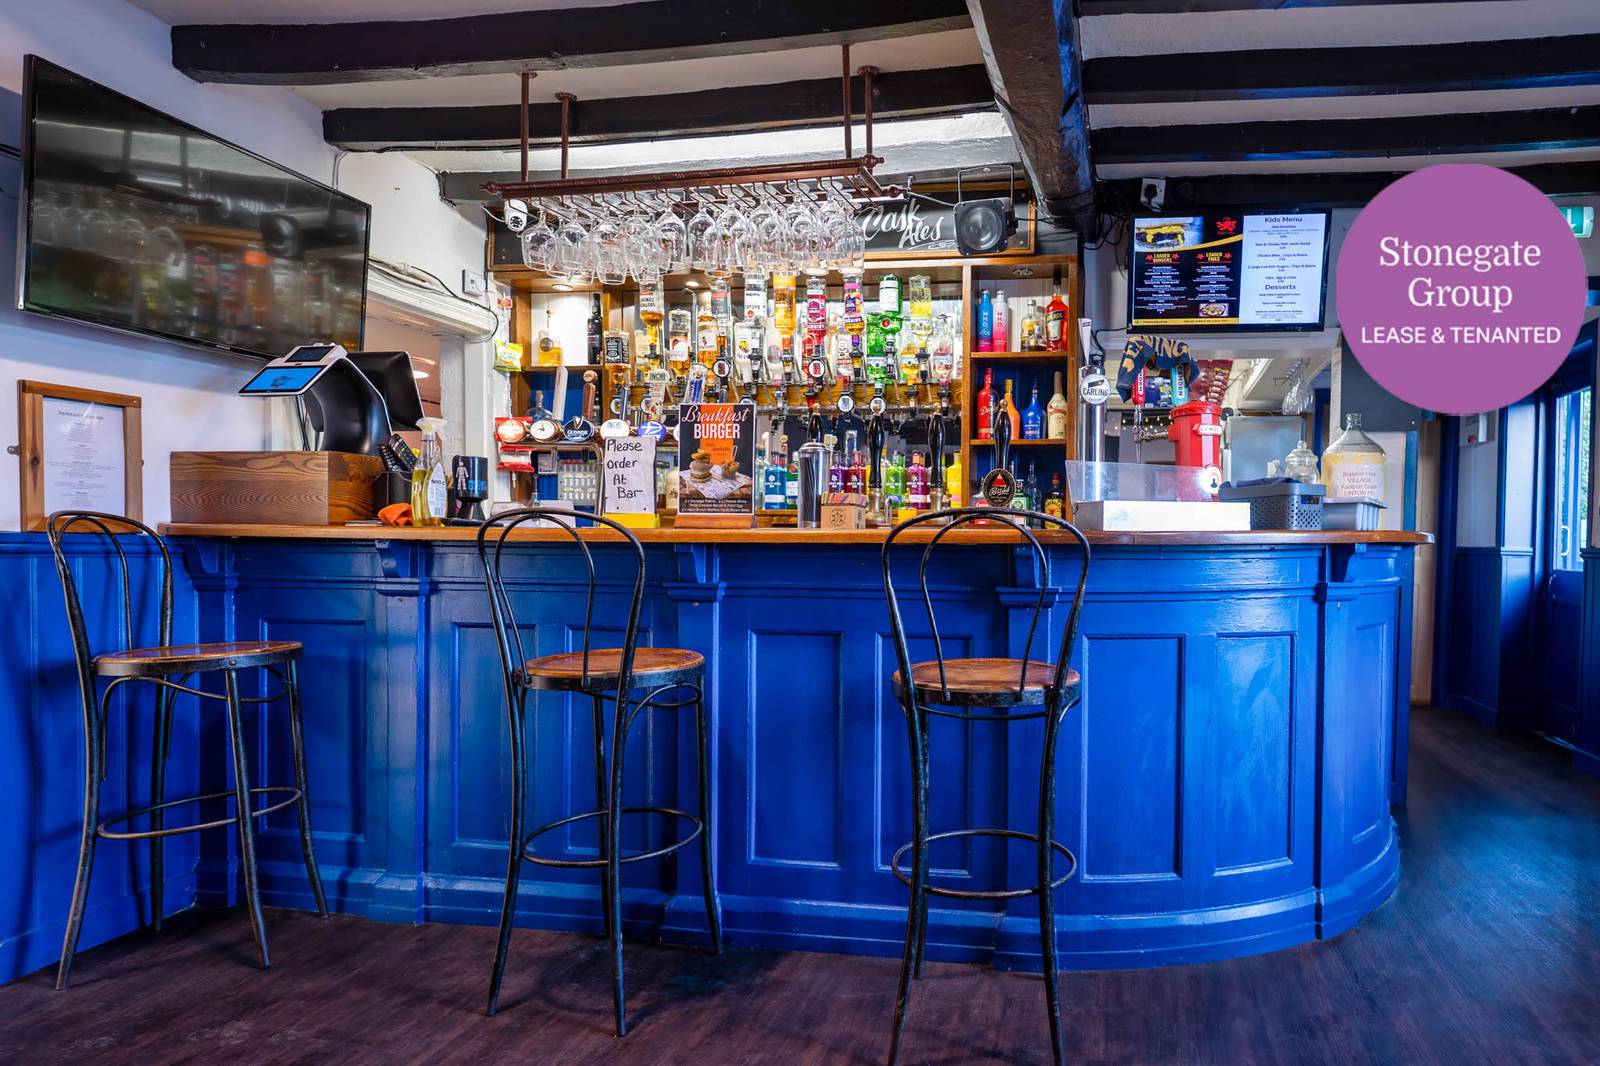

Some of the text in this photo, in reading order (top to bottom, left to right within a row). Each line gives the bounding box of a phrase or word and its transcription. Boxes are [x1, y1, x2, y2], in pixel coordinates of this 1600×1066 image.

[861, 199, 928, 241] Cask
[899, 216, 944, 249] Ales
[1082, 386, 1109, 397] CARLING
[682, 405, 751, 425] Breakfast
[694, 423, 740, 439] BURGER
[607, 439, 643, 452] Please
[607, 457, 638, 469] order
[613, 474, 627, 485] At
[617, 486, 643, 498] Bar
[989, 487, 1010, 497] Bass
